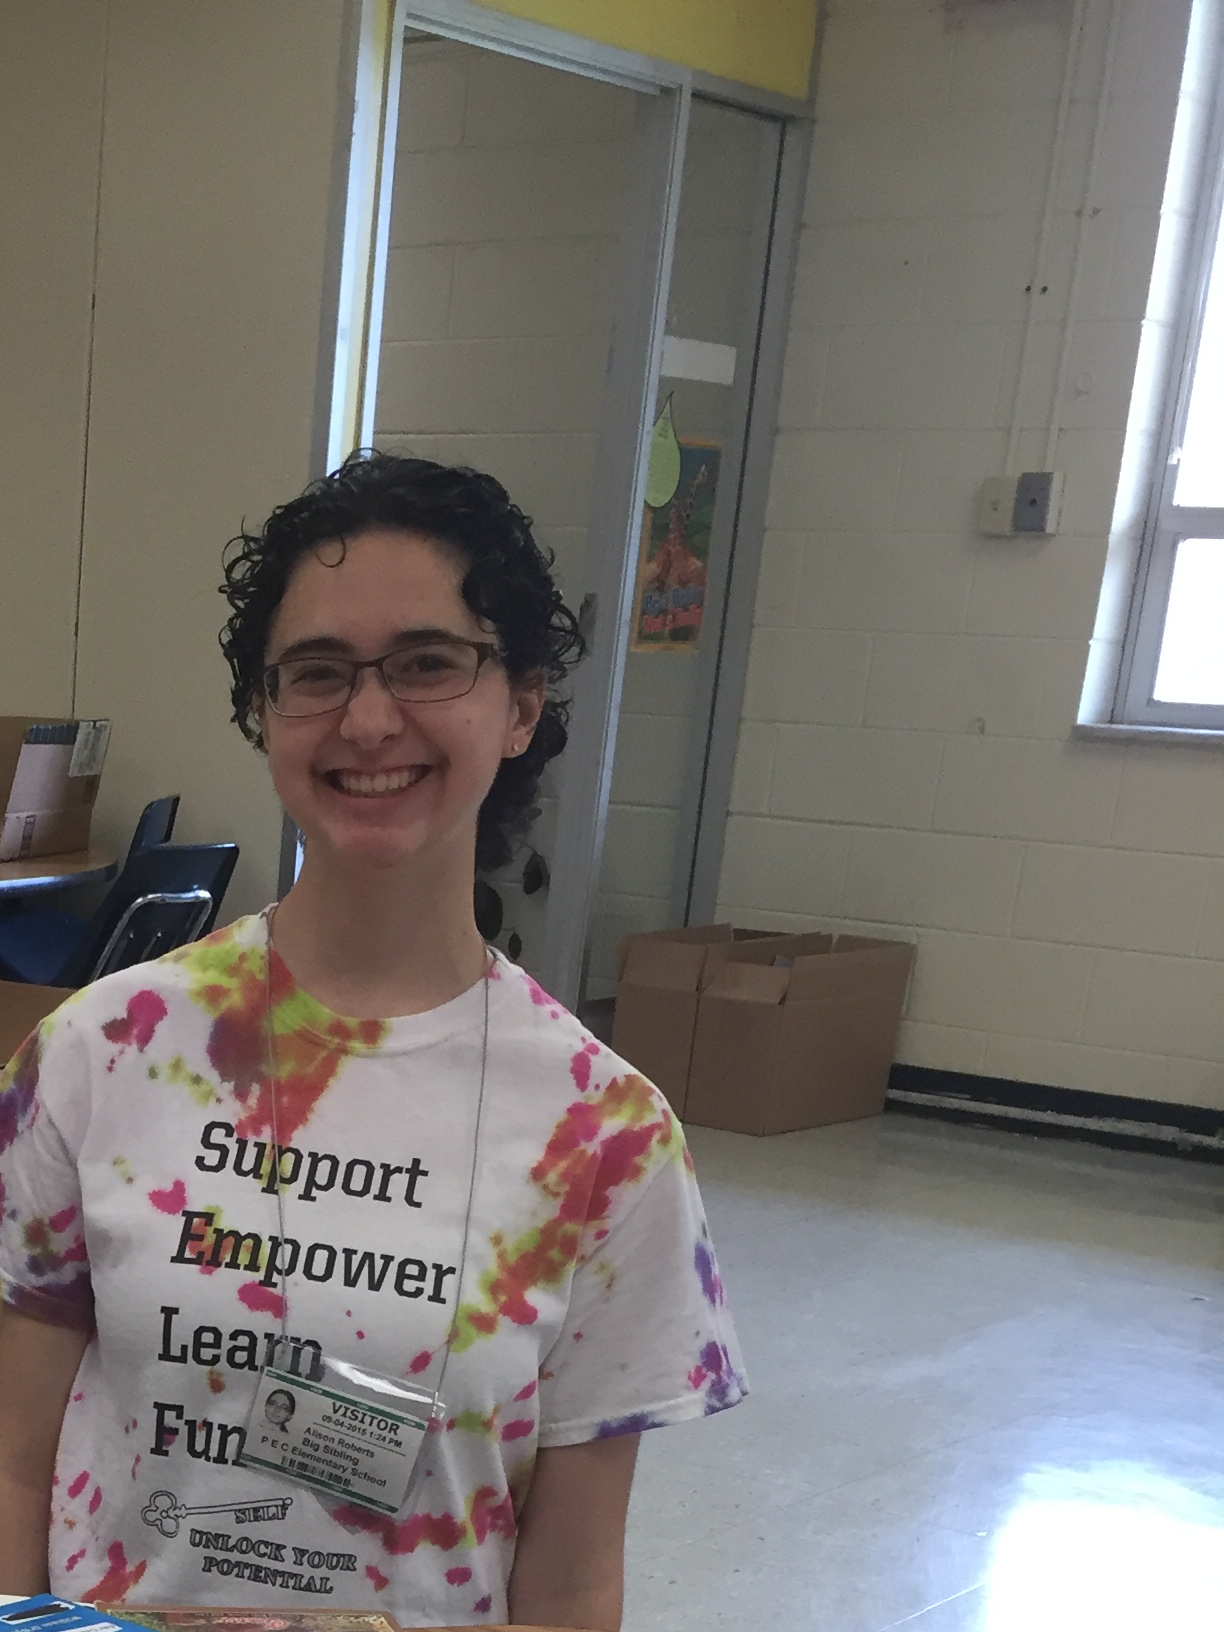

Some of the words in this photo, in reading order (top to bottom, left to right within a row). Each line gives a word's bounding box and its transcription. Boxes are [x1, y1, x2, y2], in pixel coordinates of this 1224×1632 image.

[195, 1121, 429, 1208] Support
[170, 1210, 457, 1304] Empower
[157, 1306, 324, 1382] Learn
[331, 1402, 400, 1436] VISITOR
[261, 1435, 269, 1445] P
[270, 1438, 279, 1449] E
[280, 1442, 289, 1452] C
[291, 1443, 349, 1474] Elementary
[350, 1466, 388, 1489] School
[302, 1437, 320, 1453] Big
[323, 1444, 360, 1467] Sibling
[304, 1426, 336, 1444] Alison
[337, 1436, 375, 1459] Roberts
[387, 1436, 403, 1449] PM
[189, 1528, 287, 1563] UNLOCK
[292, 1546, 358, 1572] YOUR
[202, 1556, 334, 1595] POTENTIAL
